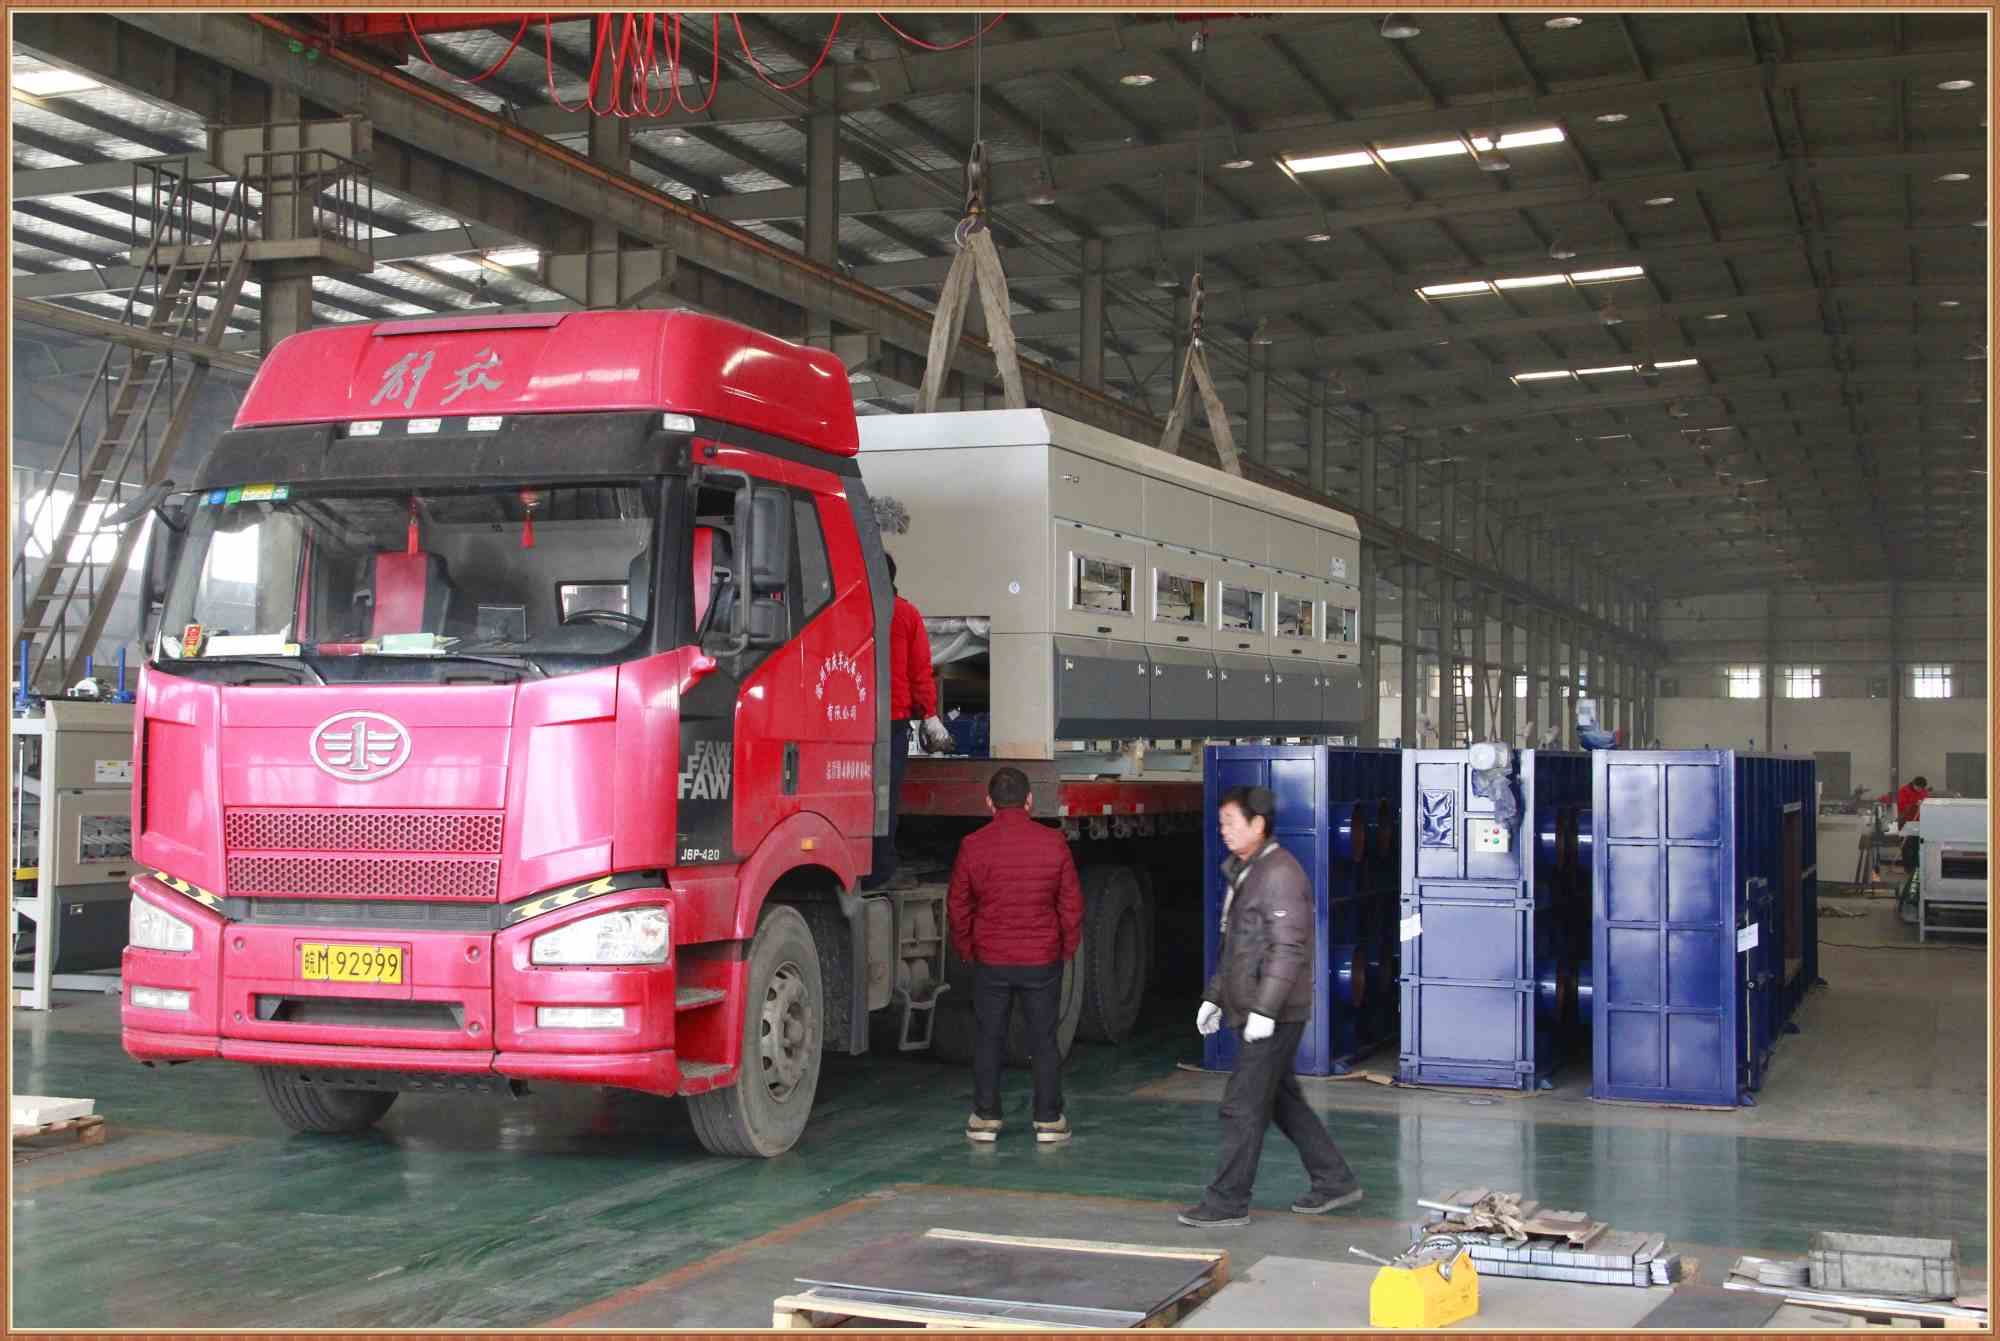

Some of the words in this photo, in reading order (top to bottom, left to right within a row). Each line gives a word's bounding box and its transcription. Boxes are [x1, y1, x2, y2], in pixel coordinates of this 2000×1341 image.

[695, 740, 732, 760] FAW
[687, 755, 731, 780] FAW
[677, 773, 731, 800] FAW
